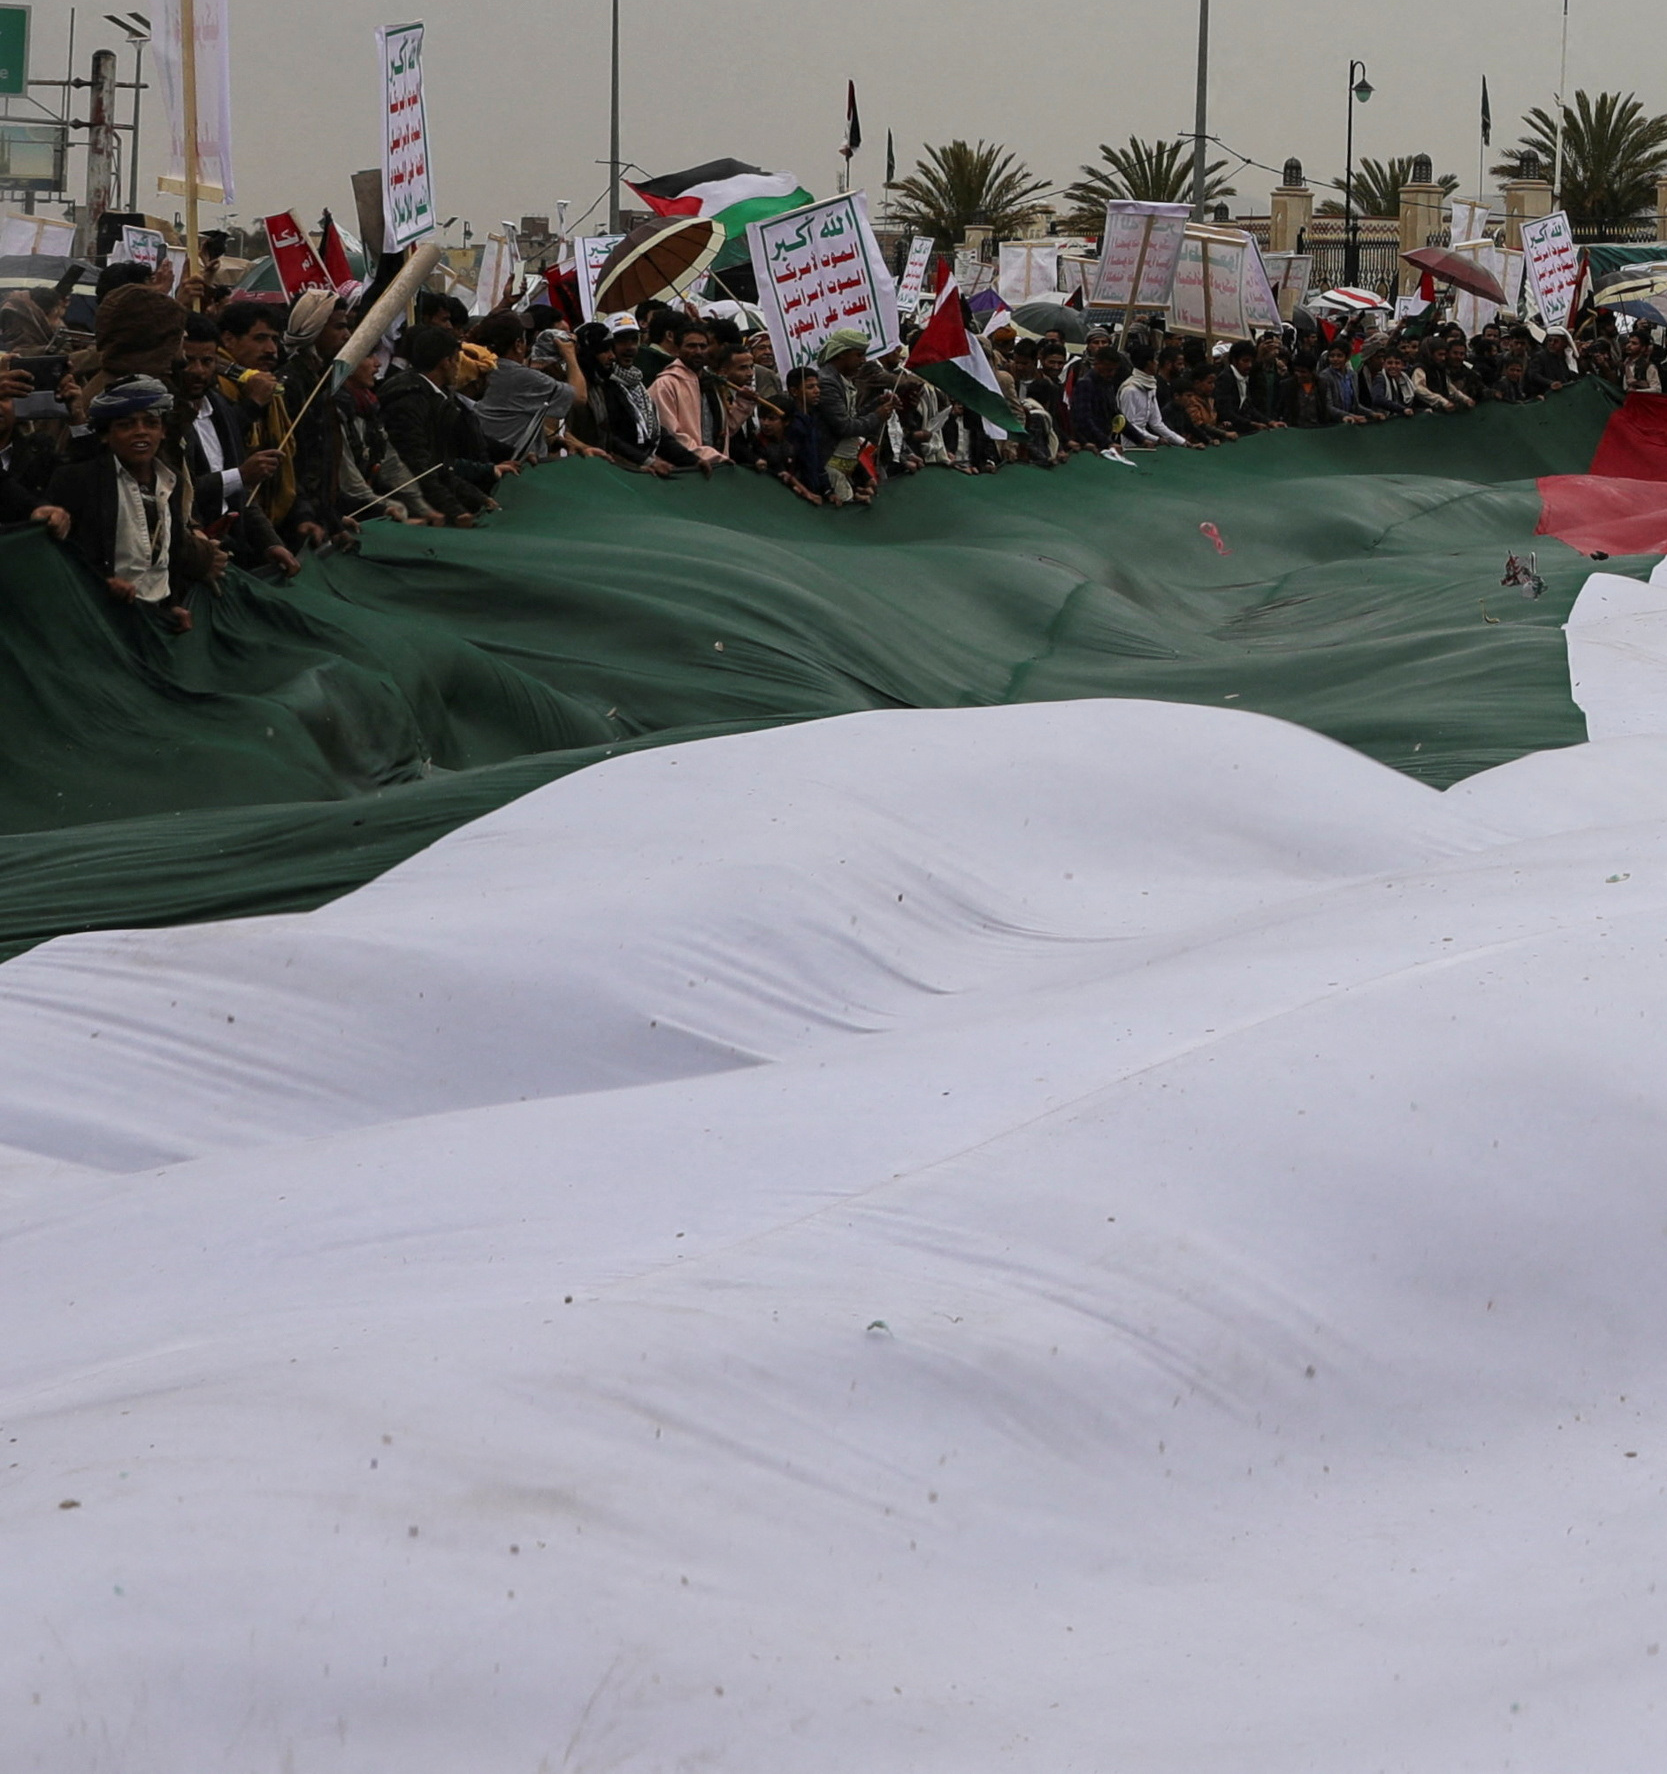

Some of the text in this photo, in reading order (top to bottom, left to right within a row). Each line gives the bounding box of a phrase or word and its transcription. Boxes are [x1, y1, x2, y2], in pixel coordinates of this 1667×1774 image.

[770, 208, 853, 262] الله أكبر
[821, 242, 860, 268] الموت
[827, 269, 866, 295] الموت
[842, 295, 871, 316] اللعنة
[789, 312, 819, 339] اليهود
